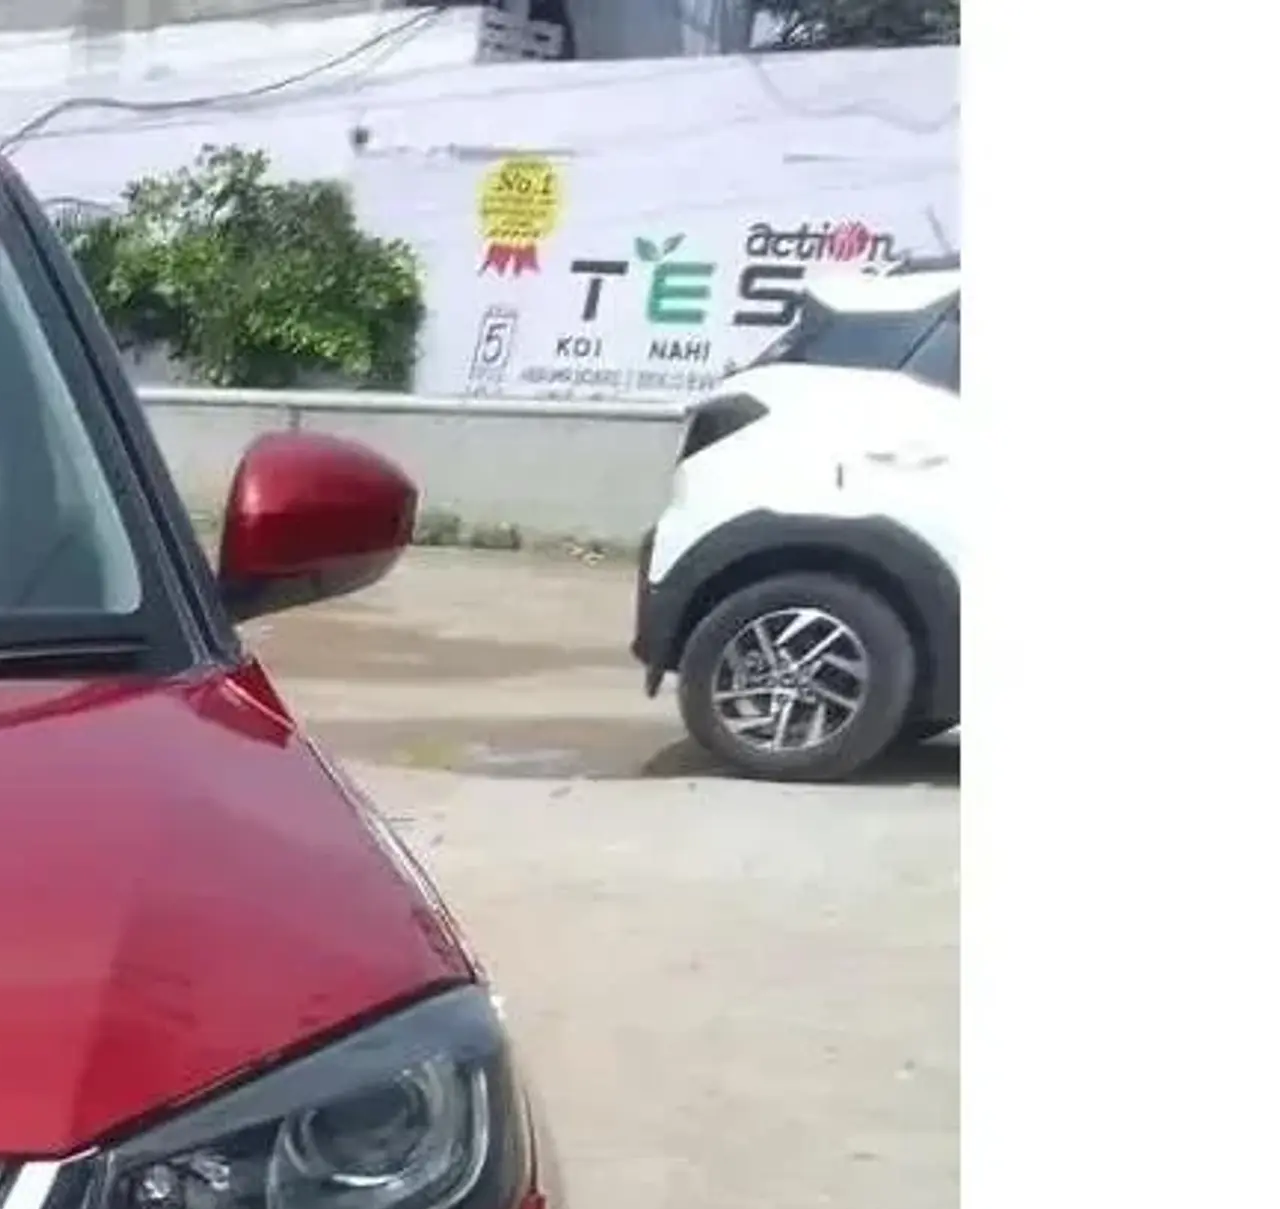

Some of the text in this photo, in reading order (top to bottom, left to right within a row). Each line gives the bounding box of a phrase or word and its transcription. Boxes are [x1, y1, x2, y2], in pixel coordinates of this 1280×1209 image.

[746, 220, 898, 262] action
[555, 335, 711, 361] KOI NAHI
